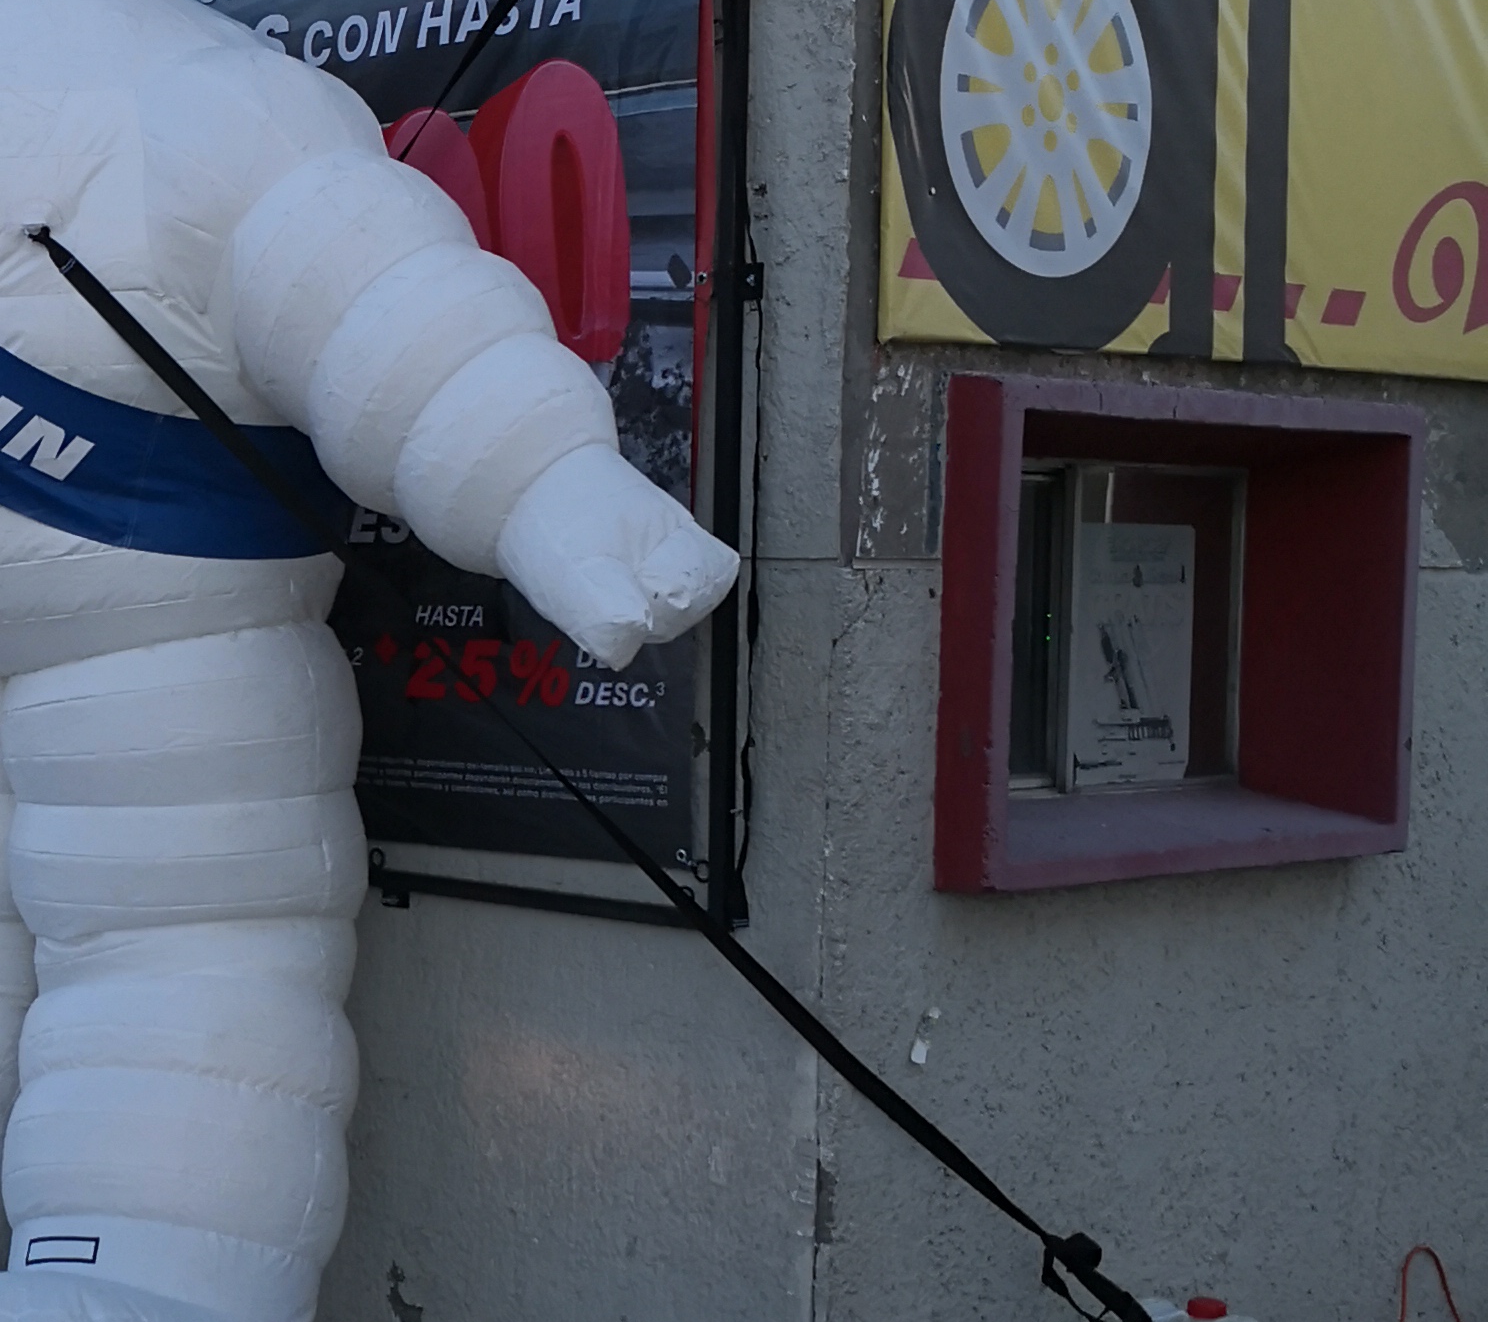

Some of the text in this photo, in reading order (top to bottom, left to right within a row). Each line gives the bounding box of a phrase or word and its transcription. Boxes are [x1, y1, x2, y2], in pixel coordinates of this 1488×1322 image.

[302, 6, 408, 69] CON
[415, 604, 485, 628] HASTA
[405, 636, 571, 708] 25%
